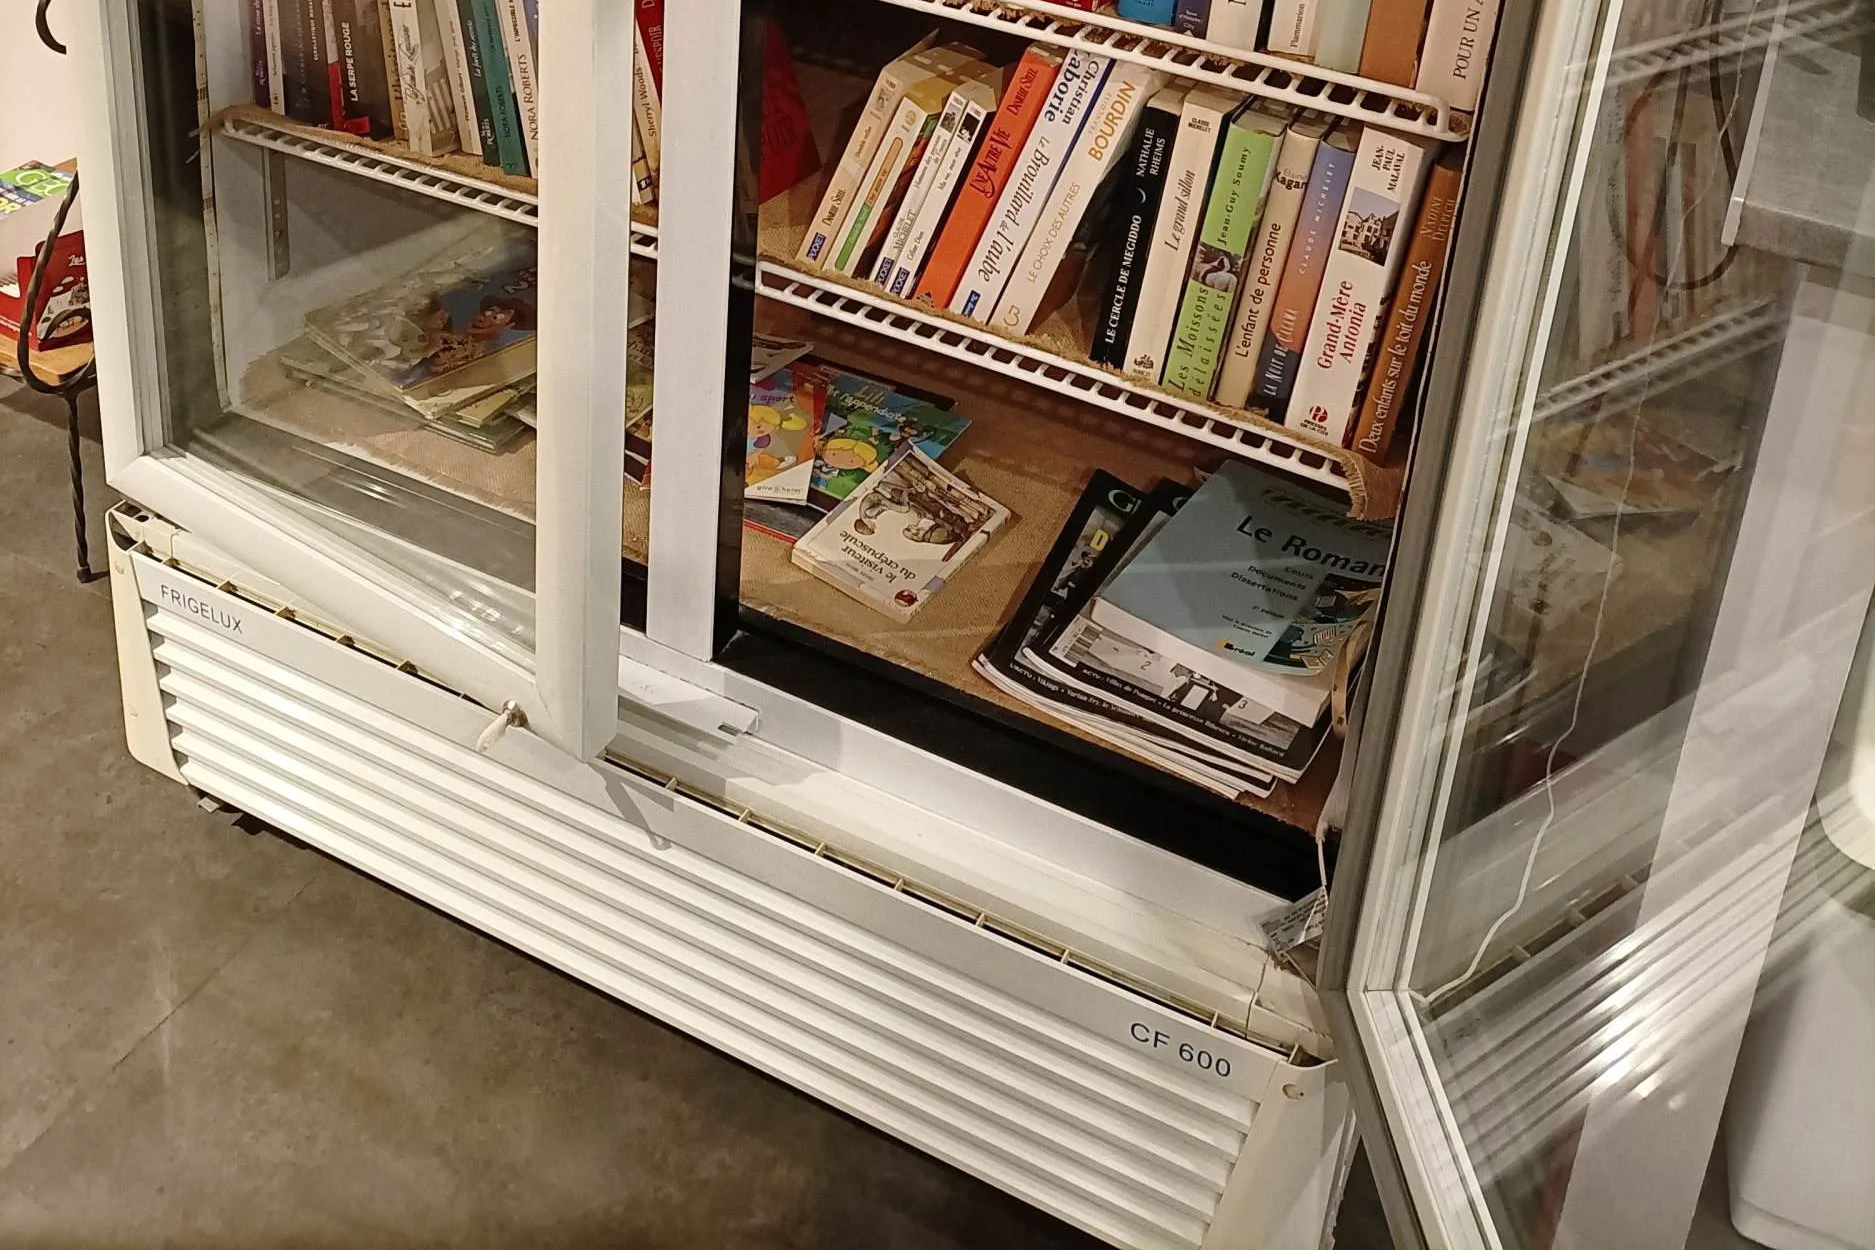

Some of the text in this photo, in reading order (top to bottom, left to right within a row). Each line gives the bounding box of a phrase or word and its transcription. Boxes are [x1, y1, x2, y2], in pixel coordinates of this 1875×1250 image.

[508, 3, 521, 43] L'IMPOSSIBLE
[1289, 3, 1305, 49] Flammarion
[1453, 39, 1475, 80] POUR
[1464, 8, 1483, 37] UN
[341, 22, 358, 101] LA SERPE ROUGE
[518, 54, 538, 141] NORA ROBERTS
[635, 67, 656, 137] Sherryl Woods
[1062, 60, 1100, 126] Christian
[1088, 80, 1136, 161] BOURDIN
[1135, 127, 1156, 178] NATHALIE
[1149, 138, 1166, 177] RHEIMS
[1371, 144, 1385, 171] JEAN-
[1381, 148, 1396, 173] PAUL
[1387, 152, 1406, 194] MALAVAL
[1164, 169, 1196, 252] Le grand sillon
[1216, 147, 1252, 246] Jean-Guy Soumy
[807, 232, 827, 260] POCKET
[893, 209, 916, 252] MICHELET
[1026, 182, 1080, 283] LE CHOIX DES AUTRES
[1105, 215, 1143, 345] LE CERCLE DE MEGIDDO
[1235, 222, 1281, 359] L'enfant de personne
[1167, 287, 1210, 393] Les Moissons
[1316, 280, 1354, 371] Grand-Mère
[1338, 302, 1368, 363] Antonia
[840, 530, 899, 569] crépuscule
[841, 546, 884, 575] visiteur
[1236, 515, 1387, 577] Le Roman
[885, 571, 896, 583] le
[900, 566, 916, 580] du
[1231, 572, 1299, 601] Dissertations
[1248, 565, 1306, 590] Documents
[160, 584, 243, 634] FRIGELUX
[1140, 660, 1152, 670] 2
[1238, 700, 1248, 710] 3
[1130, 1023, 1231, 1077] CF 600
